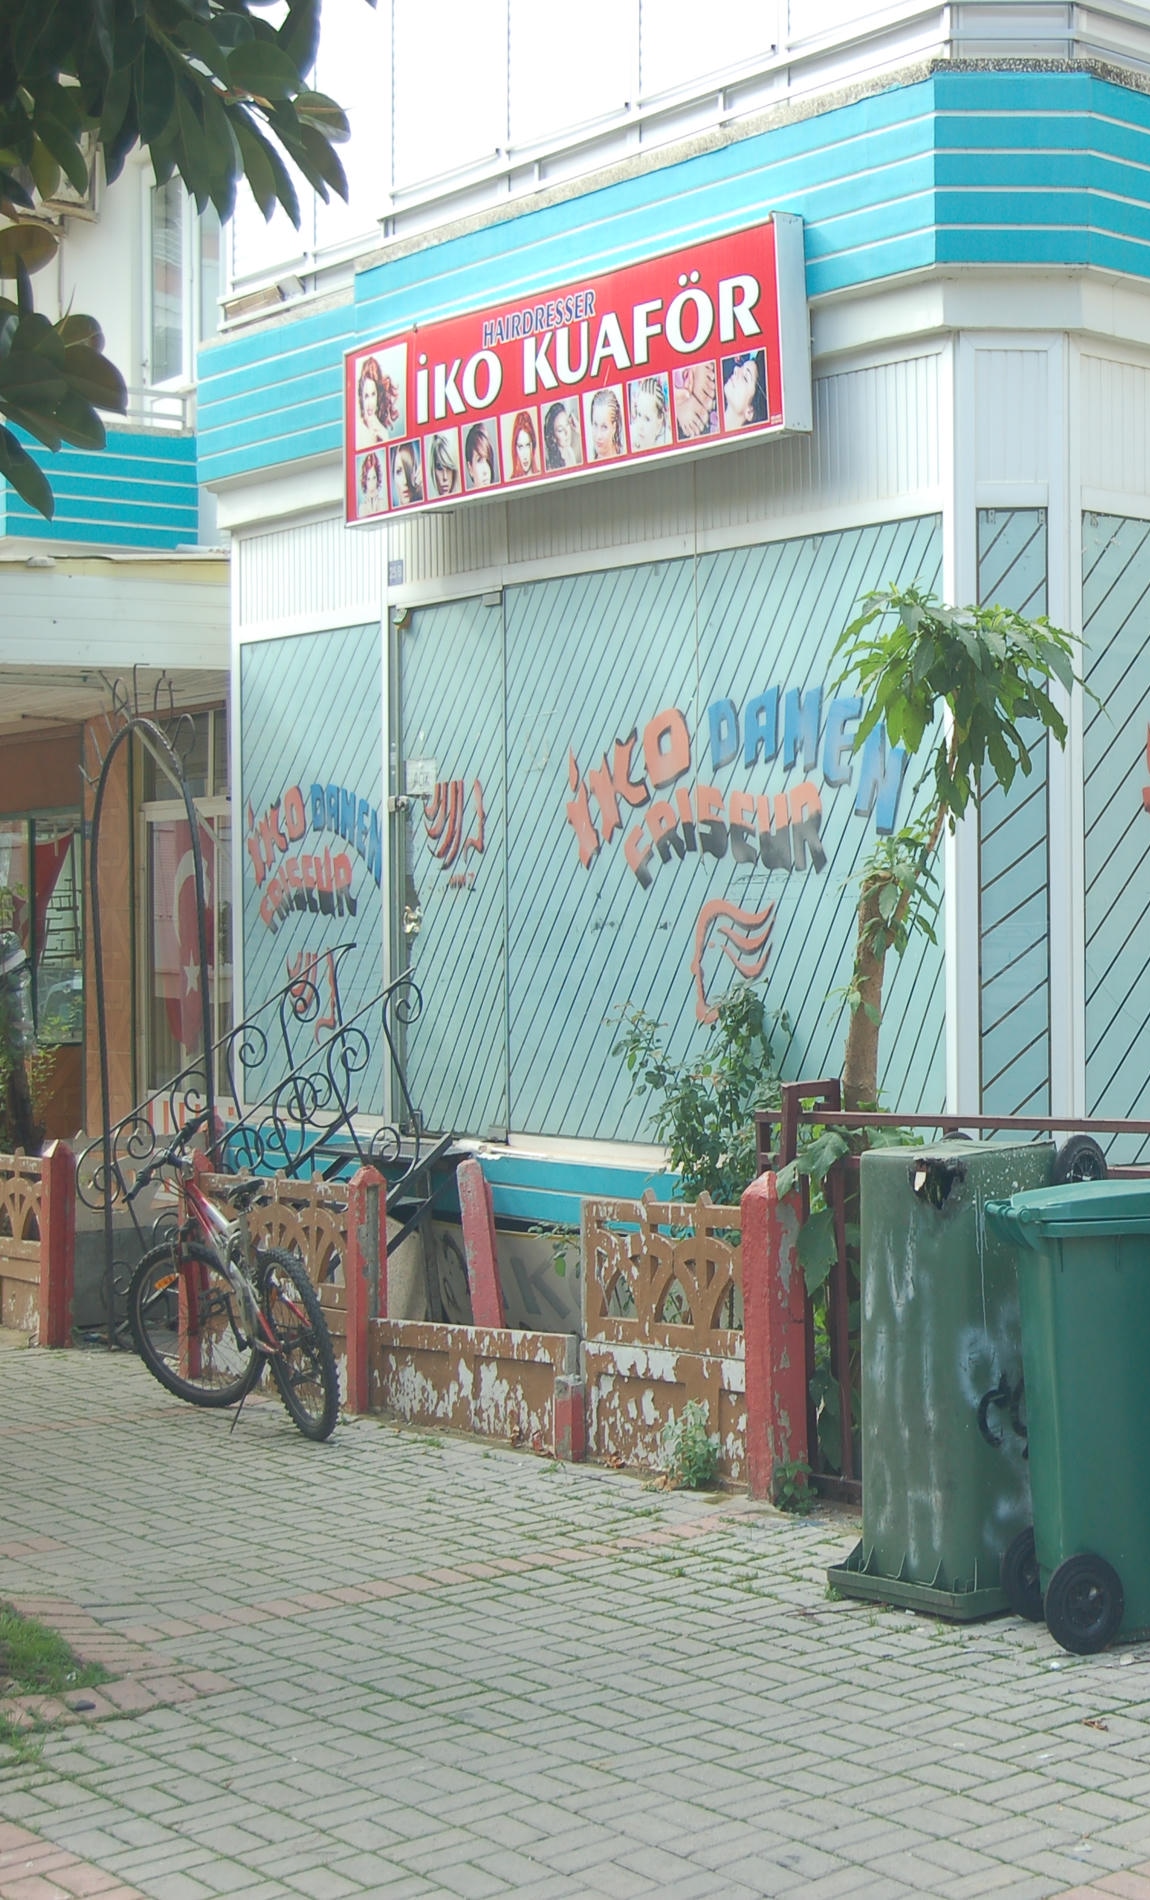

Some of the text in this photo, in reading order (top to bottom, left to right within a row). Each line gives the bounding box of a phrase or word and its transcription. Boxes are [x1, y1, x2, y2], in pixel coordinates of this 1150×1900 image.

[482, 289, 596, 349] HAIRDRESSER
[523, 269, 762, 396] KUAFÖR
[707, 684, 906, 835] DAMEN
[259, 845, 358, 935] FRISEUR
[310, 783, 382, 890] DAMEN
[623, 780, 829, 891] FRISEUR
